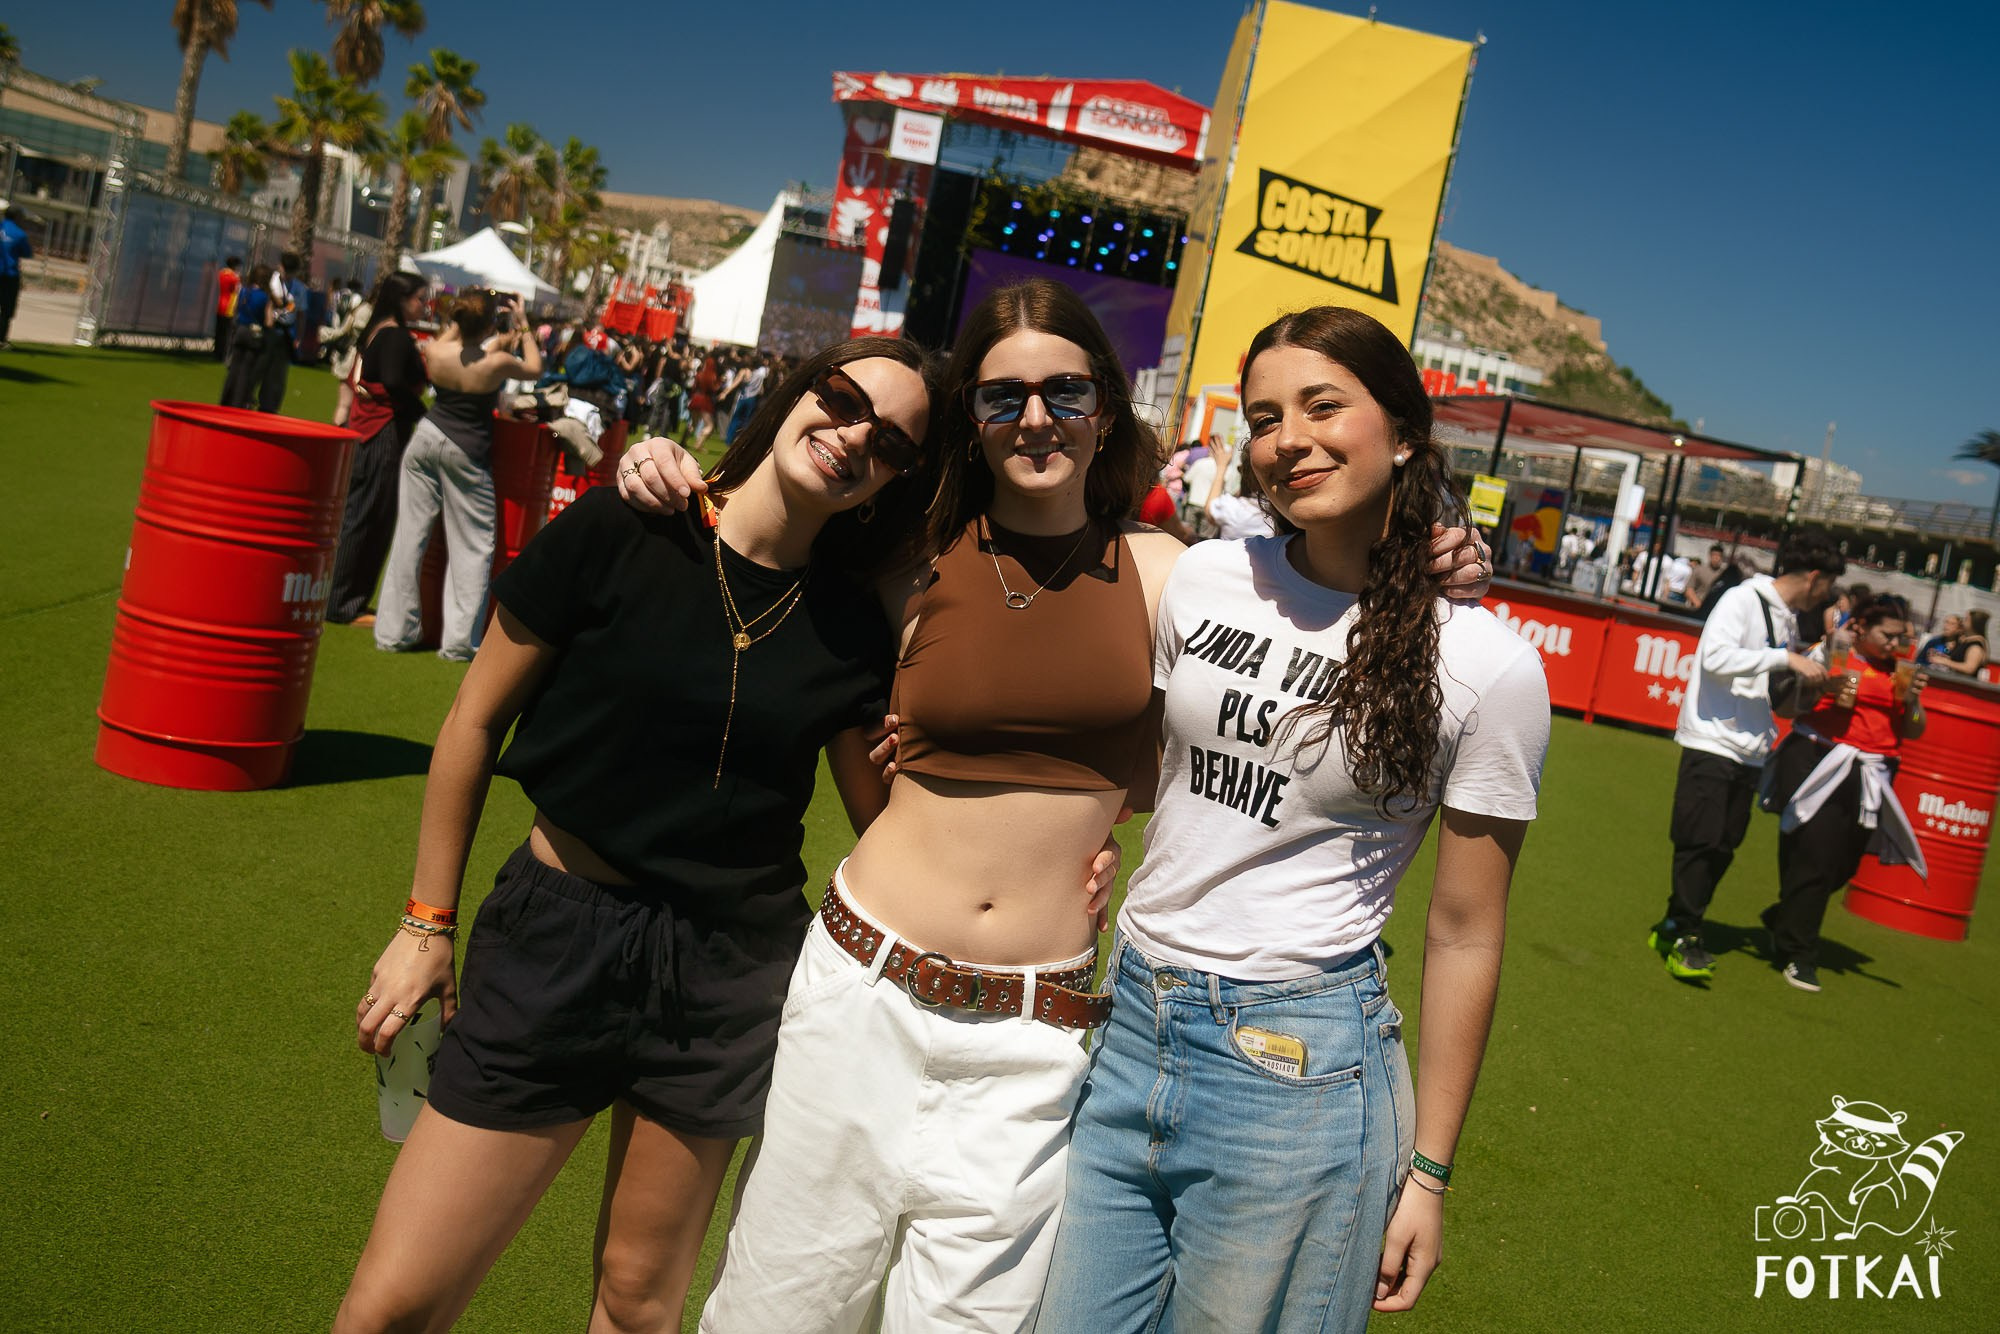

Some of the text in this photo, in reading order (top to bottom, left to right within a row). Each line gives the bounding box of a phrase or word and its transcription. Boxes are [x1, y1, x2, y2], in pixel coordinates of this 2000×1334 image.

[1090, 111, 1186, 140] SONORA
[1095, 95, 1169, 122] COSTA
[1261, 179, 1367, 236] COSTA
[1254, 230, 1386, 293] SONORA
[552, 486, 576, 502] ou
[1494, 602, 1573, 656] hou
[1183, 619, 1346, 702] LINDA VID
[1633, 633, 1696, 681] Ma
[1217, 688, 1278, 747] PLS
[1189, 745, 1291, 828] BEHAVE
[1918, 793, 1989, 826] Mahou
[1263, 1060, 1296, 1073] ADVISOR
